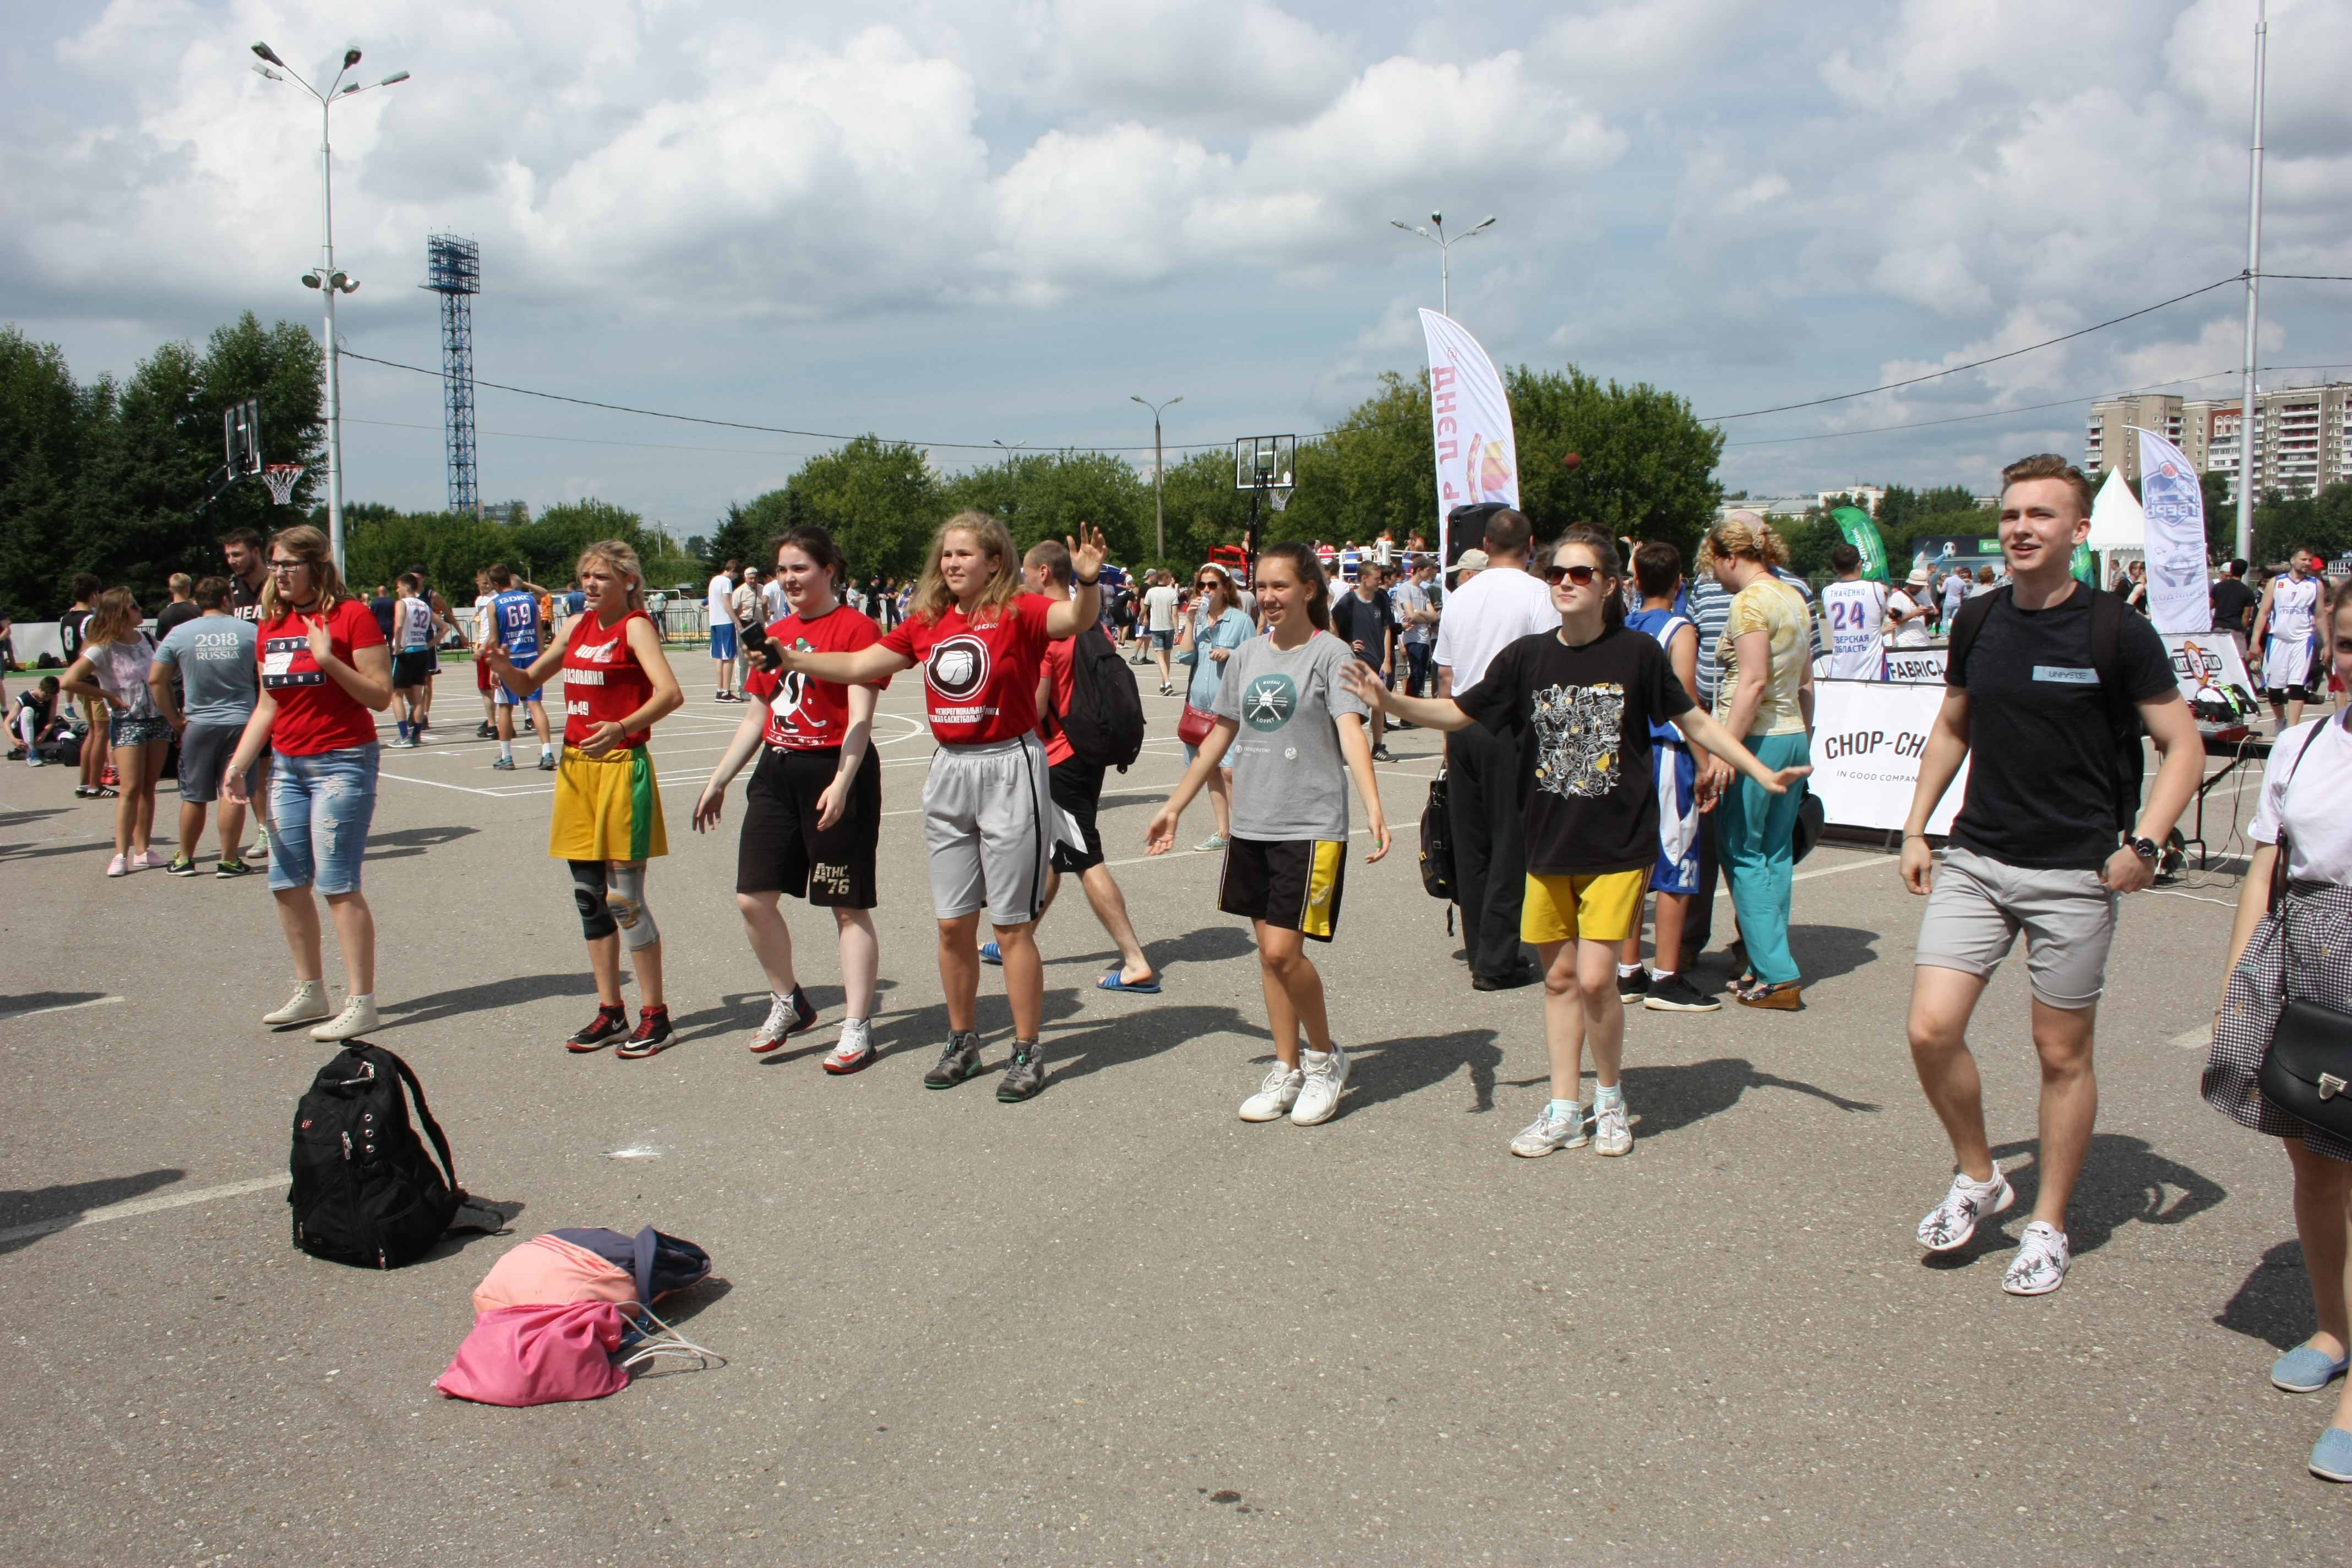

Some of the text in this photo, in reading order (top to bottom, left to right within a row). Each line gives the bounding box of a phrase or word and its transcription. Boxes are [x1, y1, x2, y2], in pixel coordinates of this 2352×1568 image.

[1831, 588, 1865, 597] ТКАЧЕНКО
[235, 604, 265, 619] HEA
[413, 608, 428, 629] 32
[507, 603, 531, 627] 69
[1831, 600, 1865, 631] 24
[195, 633, 239, 647] 2018
[1833, 634, 1869, 644] ТВЕРСКАЯ
[196, 651, 240, 661] RUSSIA
[1834, 645, 1867, 653] ОБЛАСТЬ
[1887, 660, 1945, 679] FABRICA
[2173, 657, 2190, 671] ART
[1849, 772, 1877, 780] GOOD
[1880, 774, 1918, 783] COMPAN
[813, 862, 850, 883] ATHL
[1678, 858, 1698, 888] 23
[827, 878, 850, 895] 76
